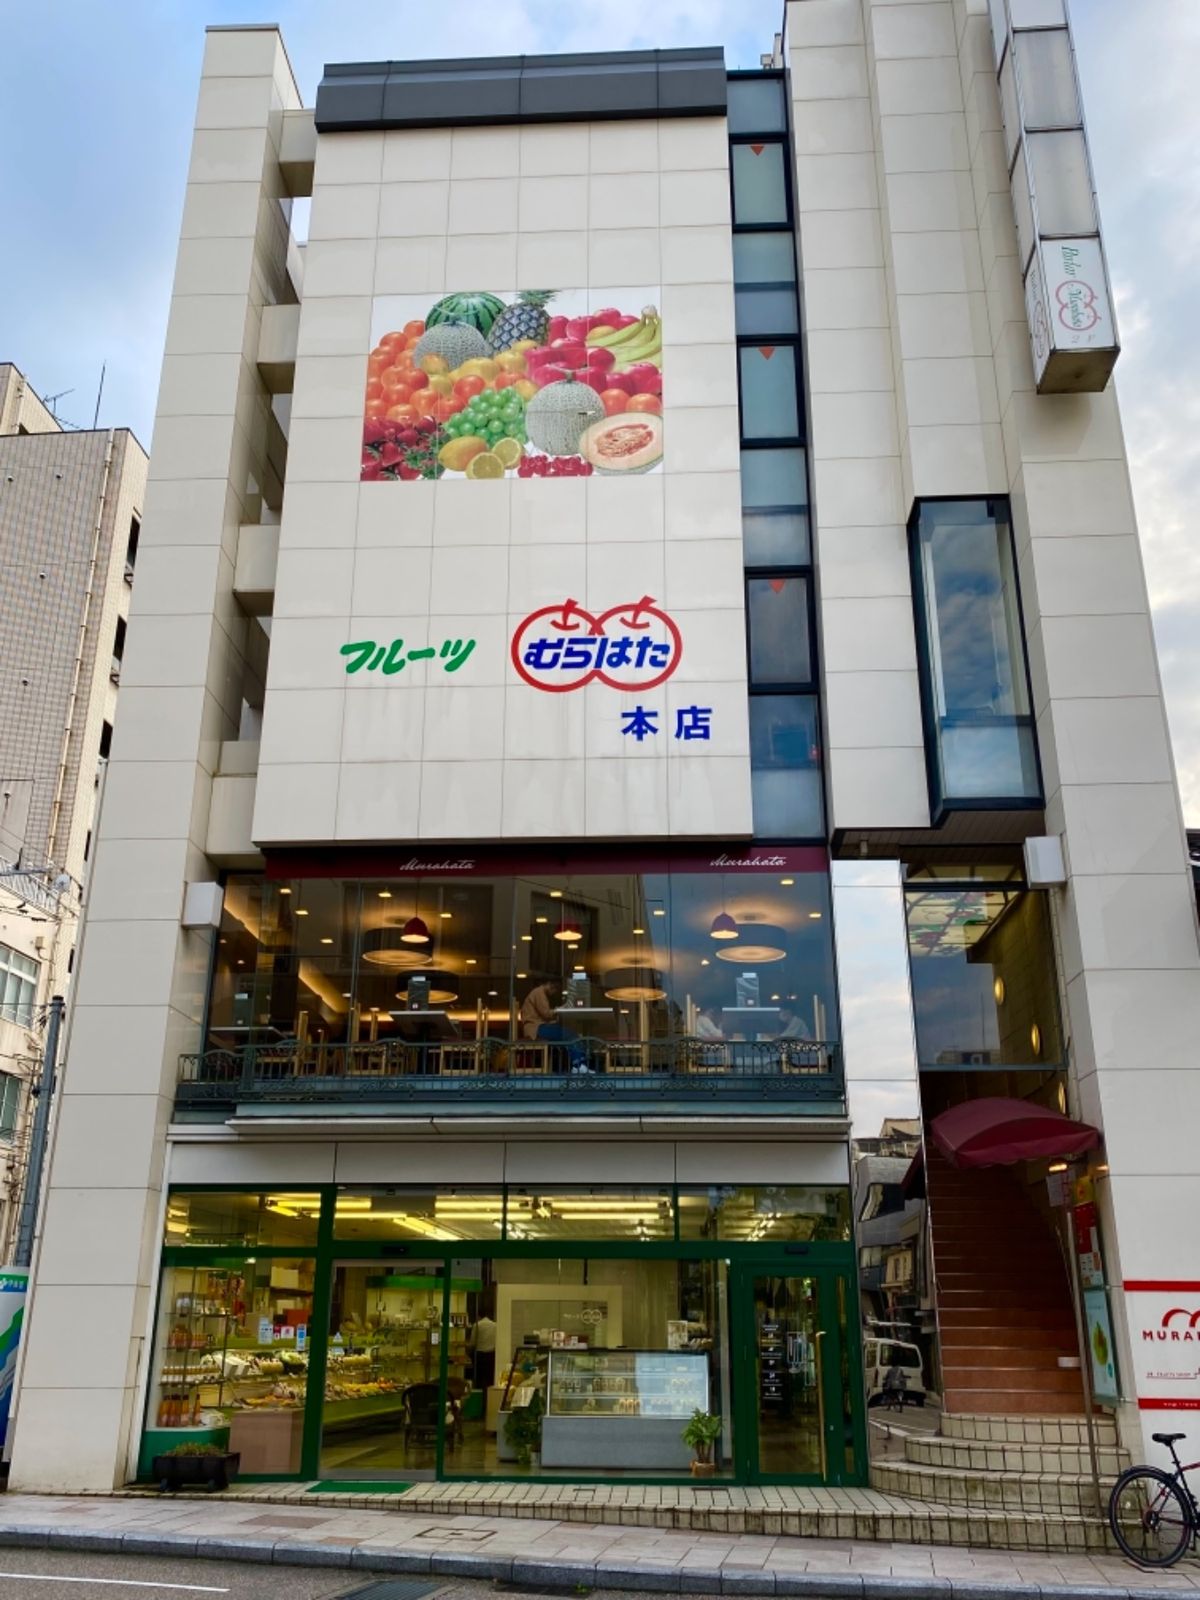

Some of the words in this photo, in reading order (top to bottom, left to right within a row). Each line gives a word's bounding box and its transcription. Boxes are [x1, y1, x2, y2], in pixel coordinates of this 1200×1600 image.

[340, 639, 475, 674] フルーツ
[524, 637, 670, 669] むらはた
[621, 706, 713, 741] 本店
[399, 857, 476, 871] Murahata
[709, 853, 787, 867] Murahata
